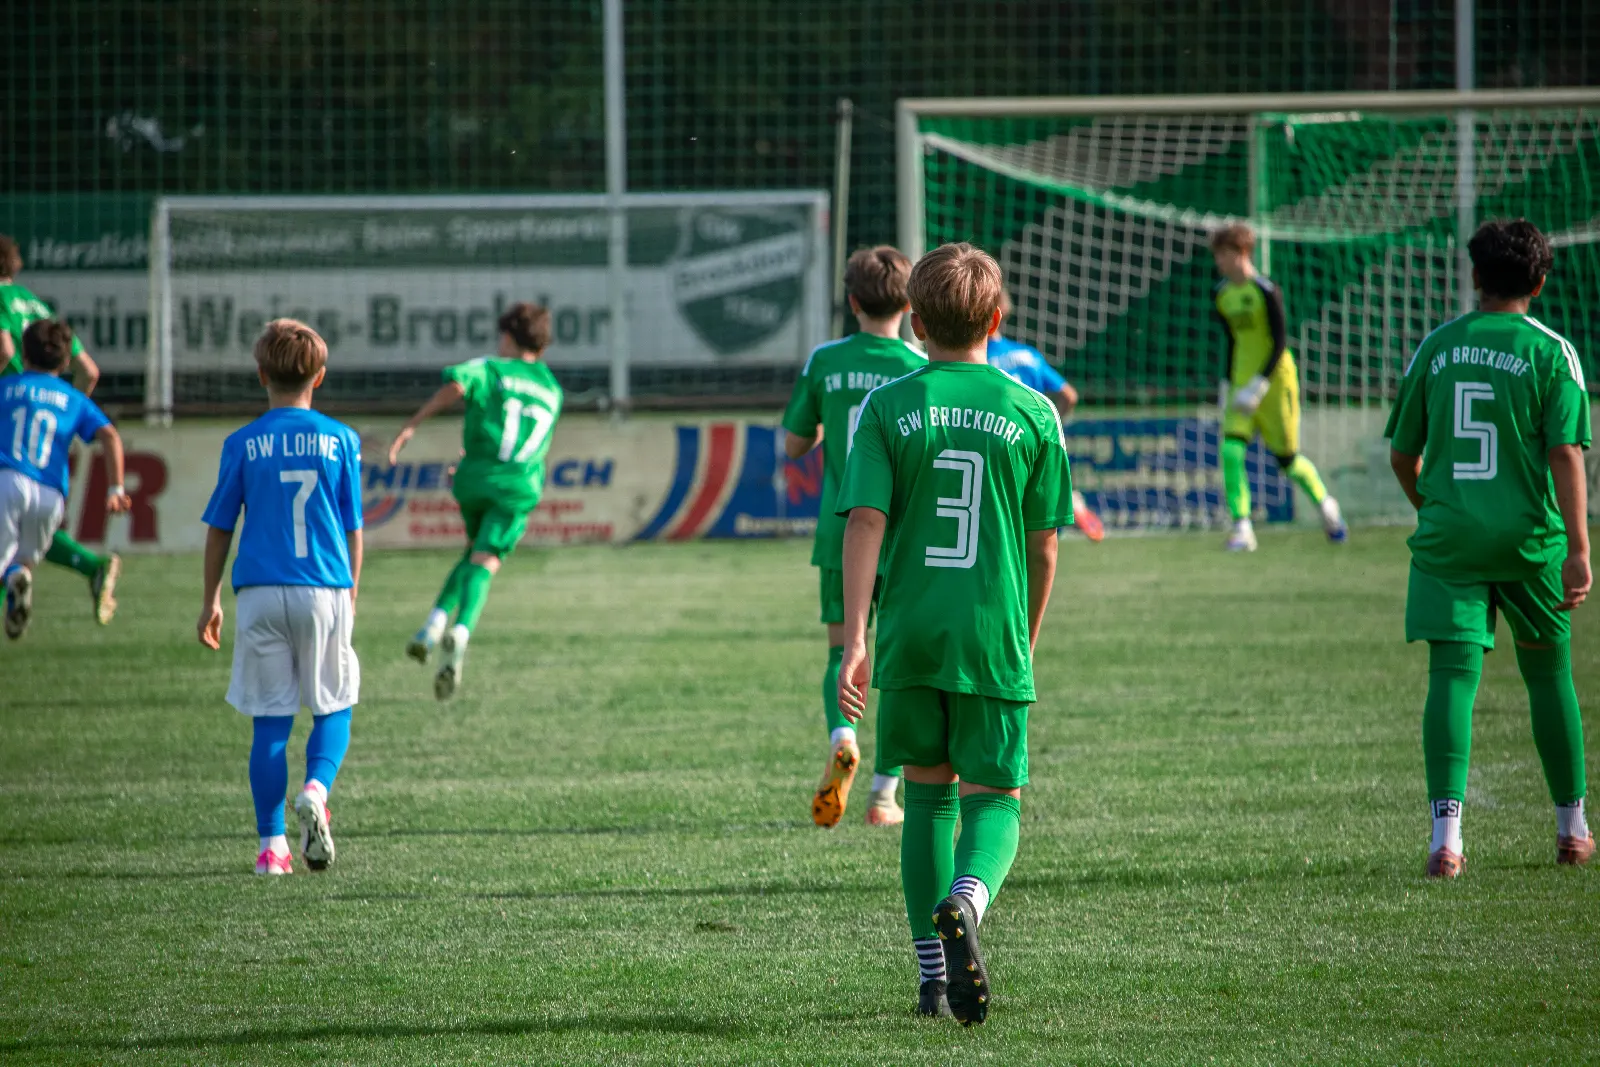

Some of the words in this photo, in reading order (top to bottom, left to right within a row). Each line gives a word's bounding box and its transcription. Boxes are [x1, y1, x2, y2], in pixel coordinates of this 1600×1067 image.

[1431, 352, 1448, 375] GW
[1452, 346, 1531, 377] BROCKDORF
[11, 406, 58, 470] 10
[246, 433, 274, 461] BW
[283, 432, 340, 462] LOHNE
[498, 396, 554, 463] 17
[897, 409, 923, 437] GW
[929, 406, 1025, 446] BROCKDORF
[1452, 381, 1498, 480] 5
[279, 470, 319, 559] 7
[925, 449, 985, 569] 3
[1436, 800, 1458, 817] FS
